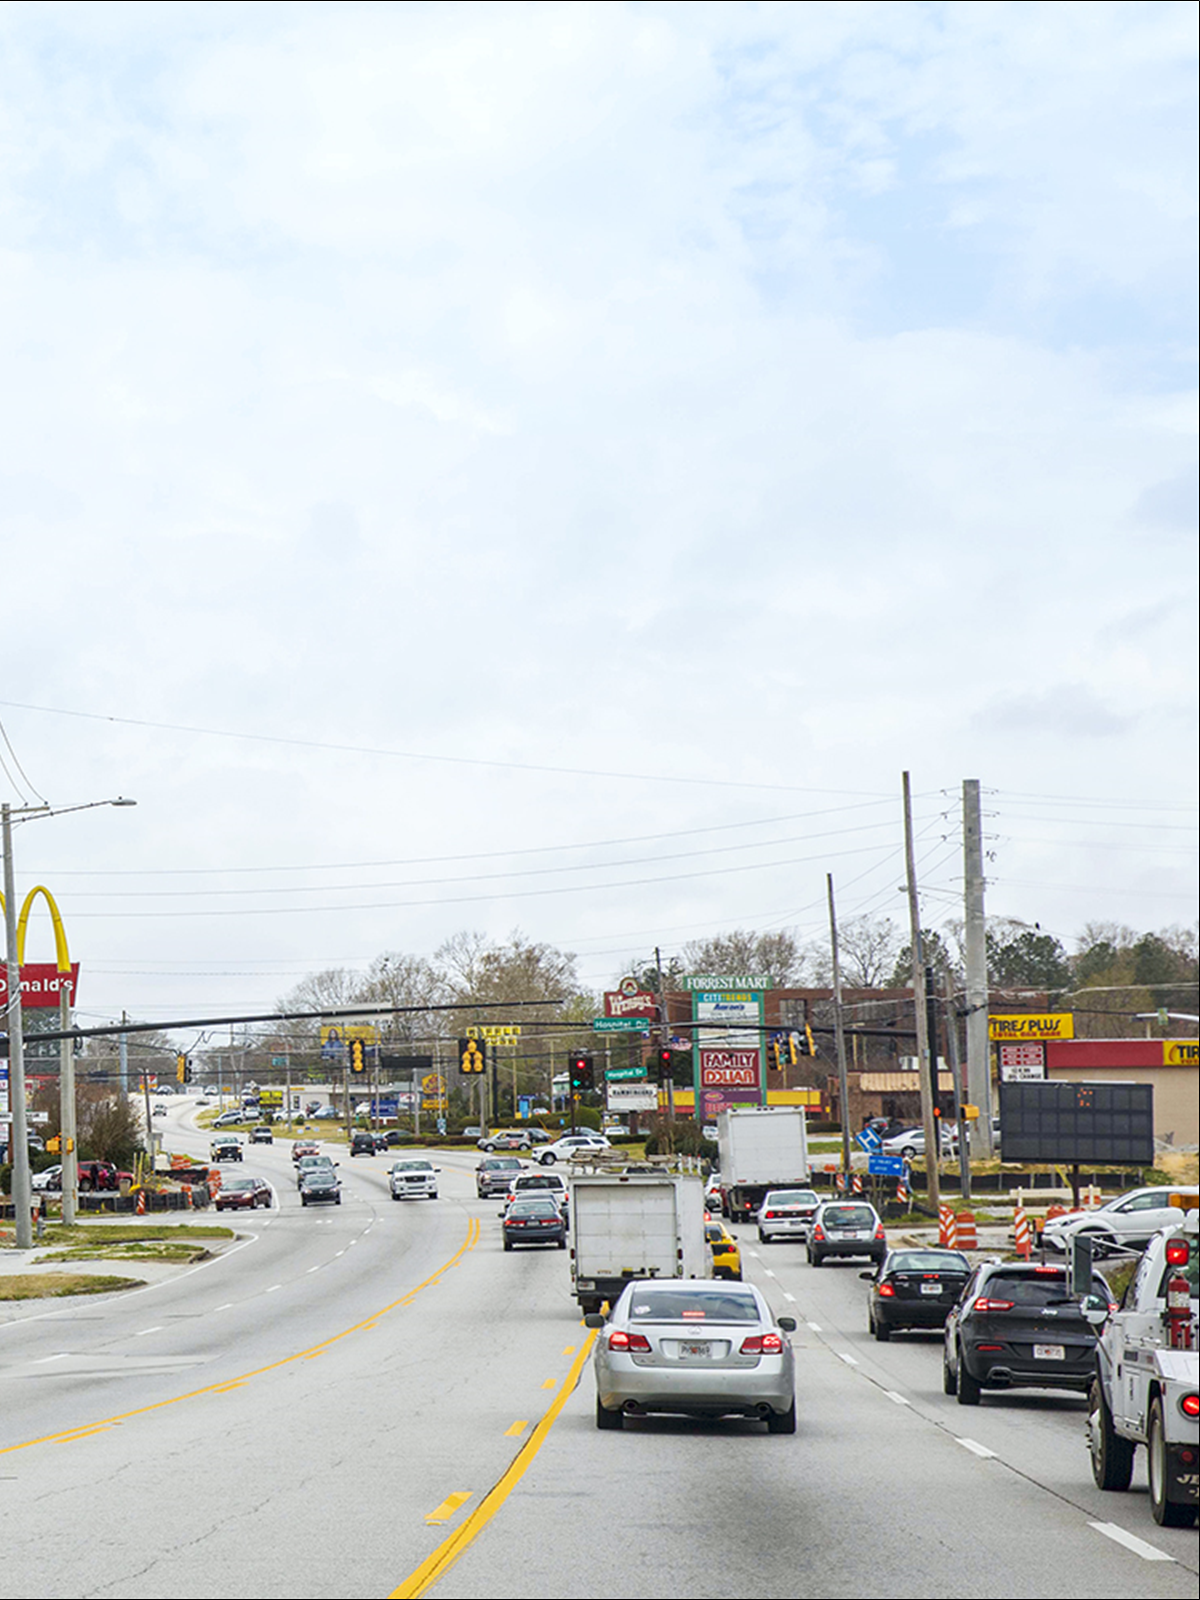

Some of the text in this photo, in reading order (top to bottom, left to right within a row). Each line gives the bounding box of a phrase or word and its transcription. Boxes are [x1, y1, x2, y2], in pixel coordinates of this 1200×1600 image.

[687, 977, 767, 989] FORREST MART
[991, 1019, 1061, 1032] TIRES PLUS
[704, 1052, 756, 1068] FAMILY
[704, 1069, 755, 1084] DOLLAR
